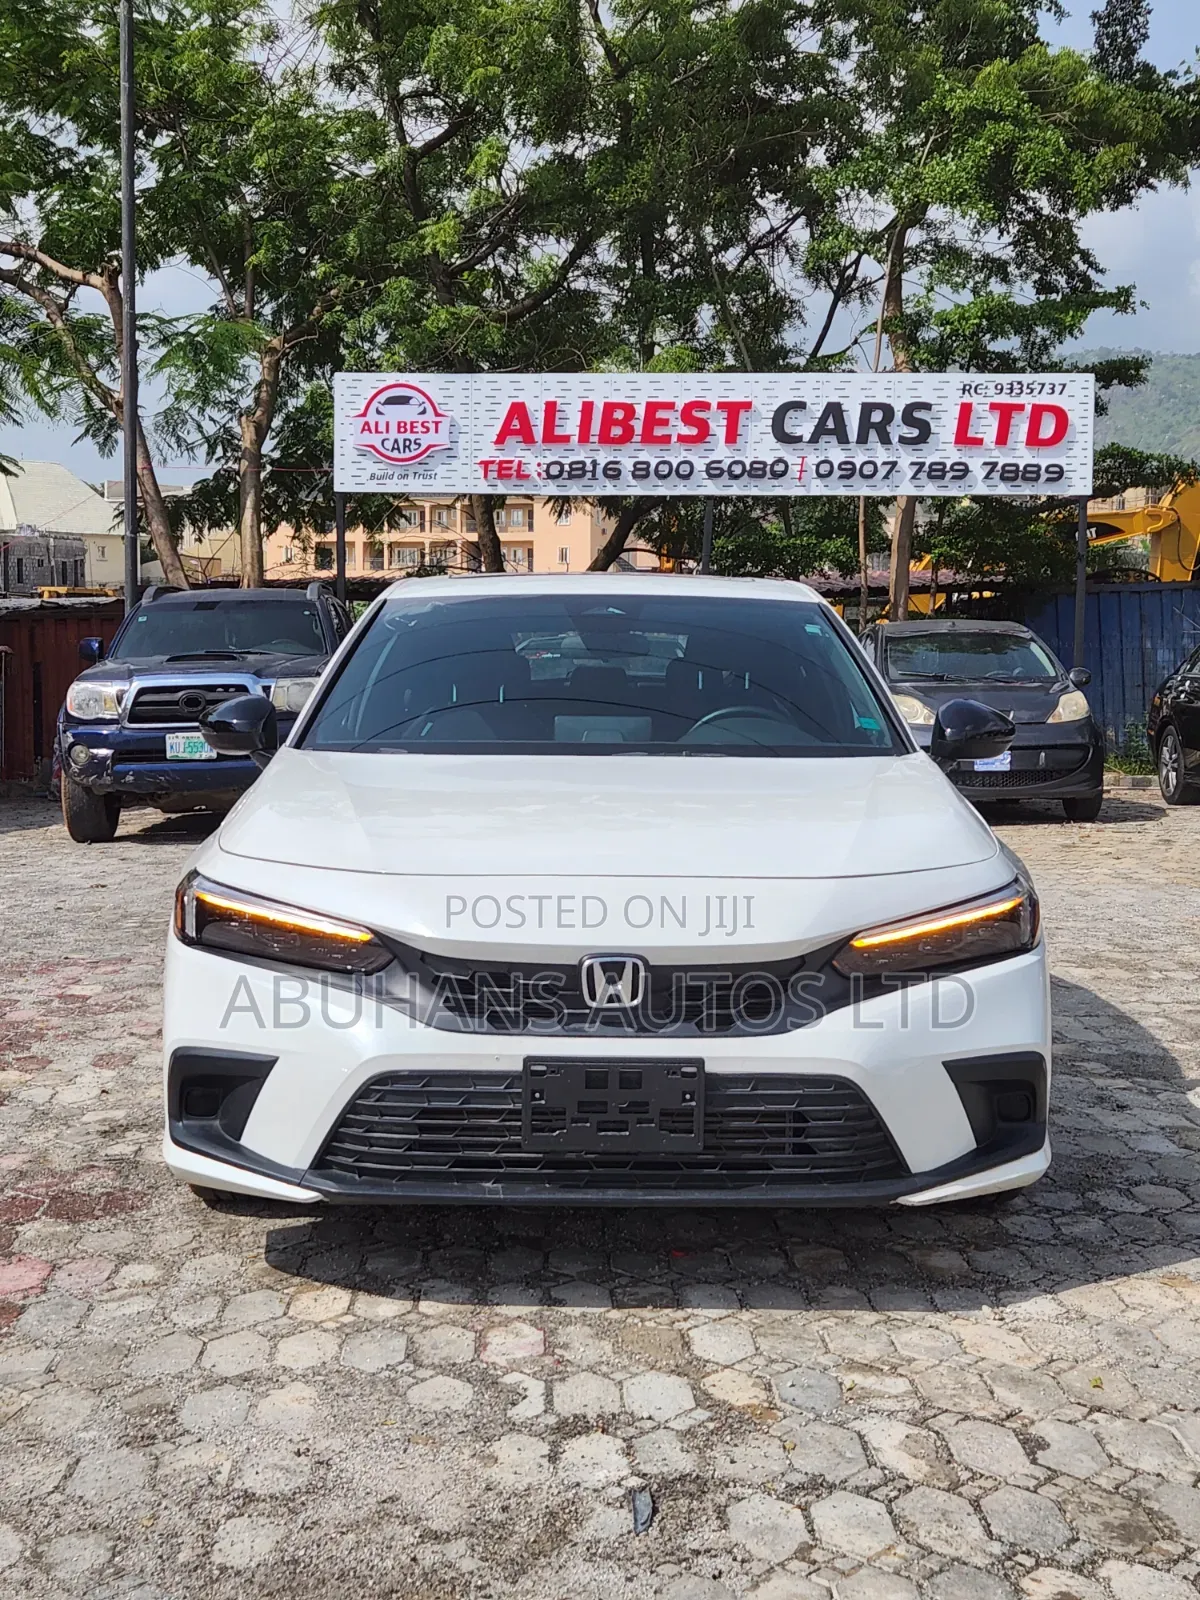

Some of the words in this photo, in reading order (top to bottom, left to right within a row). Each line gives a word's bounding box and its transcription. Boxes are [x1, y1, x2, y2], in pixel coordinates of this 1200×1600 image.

[994, 382, 1067, 396] 9335737
[360, 420, 390, 434] ALI
[397, 420, 442, 434] BEST
[494, 400, 752, 446] ALIBEST
[771, 400, 932, 445] CARS
[954, 401, 1069, 448] LTD
[381, 437, 422, 454] CARS
[369, 471, 395, 481] Build
[397, 472, 409, 480] on
[412, 471, 438, 480] Trust
[632, 459, 695, 481] 800
[705, 458, 789, 481] 6080
[815, 459, 898, 482] 0907
[909, 460, 970, 482] 789
[982, 461, 1065, 484] 7889
